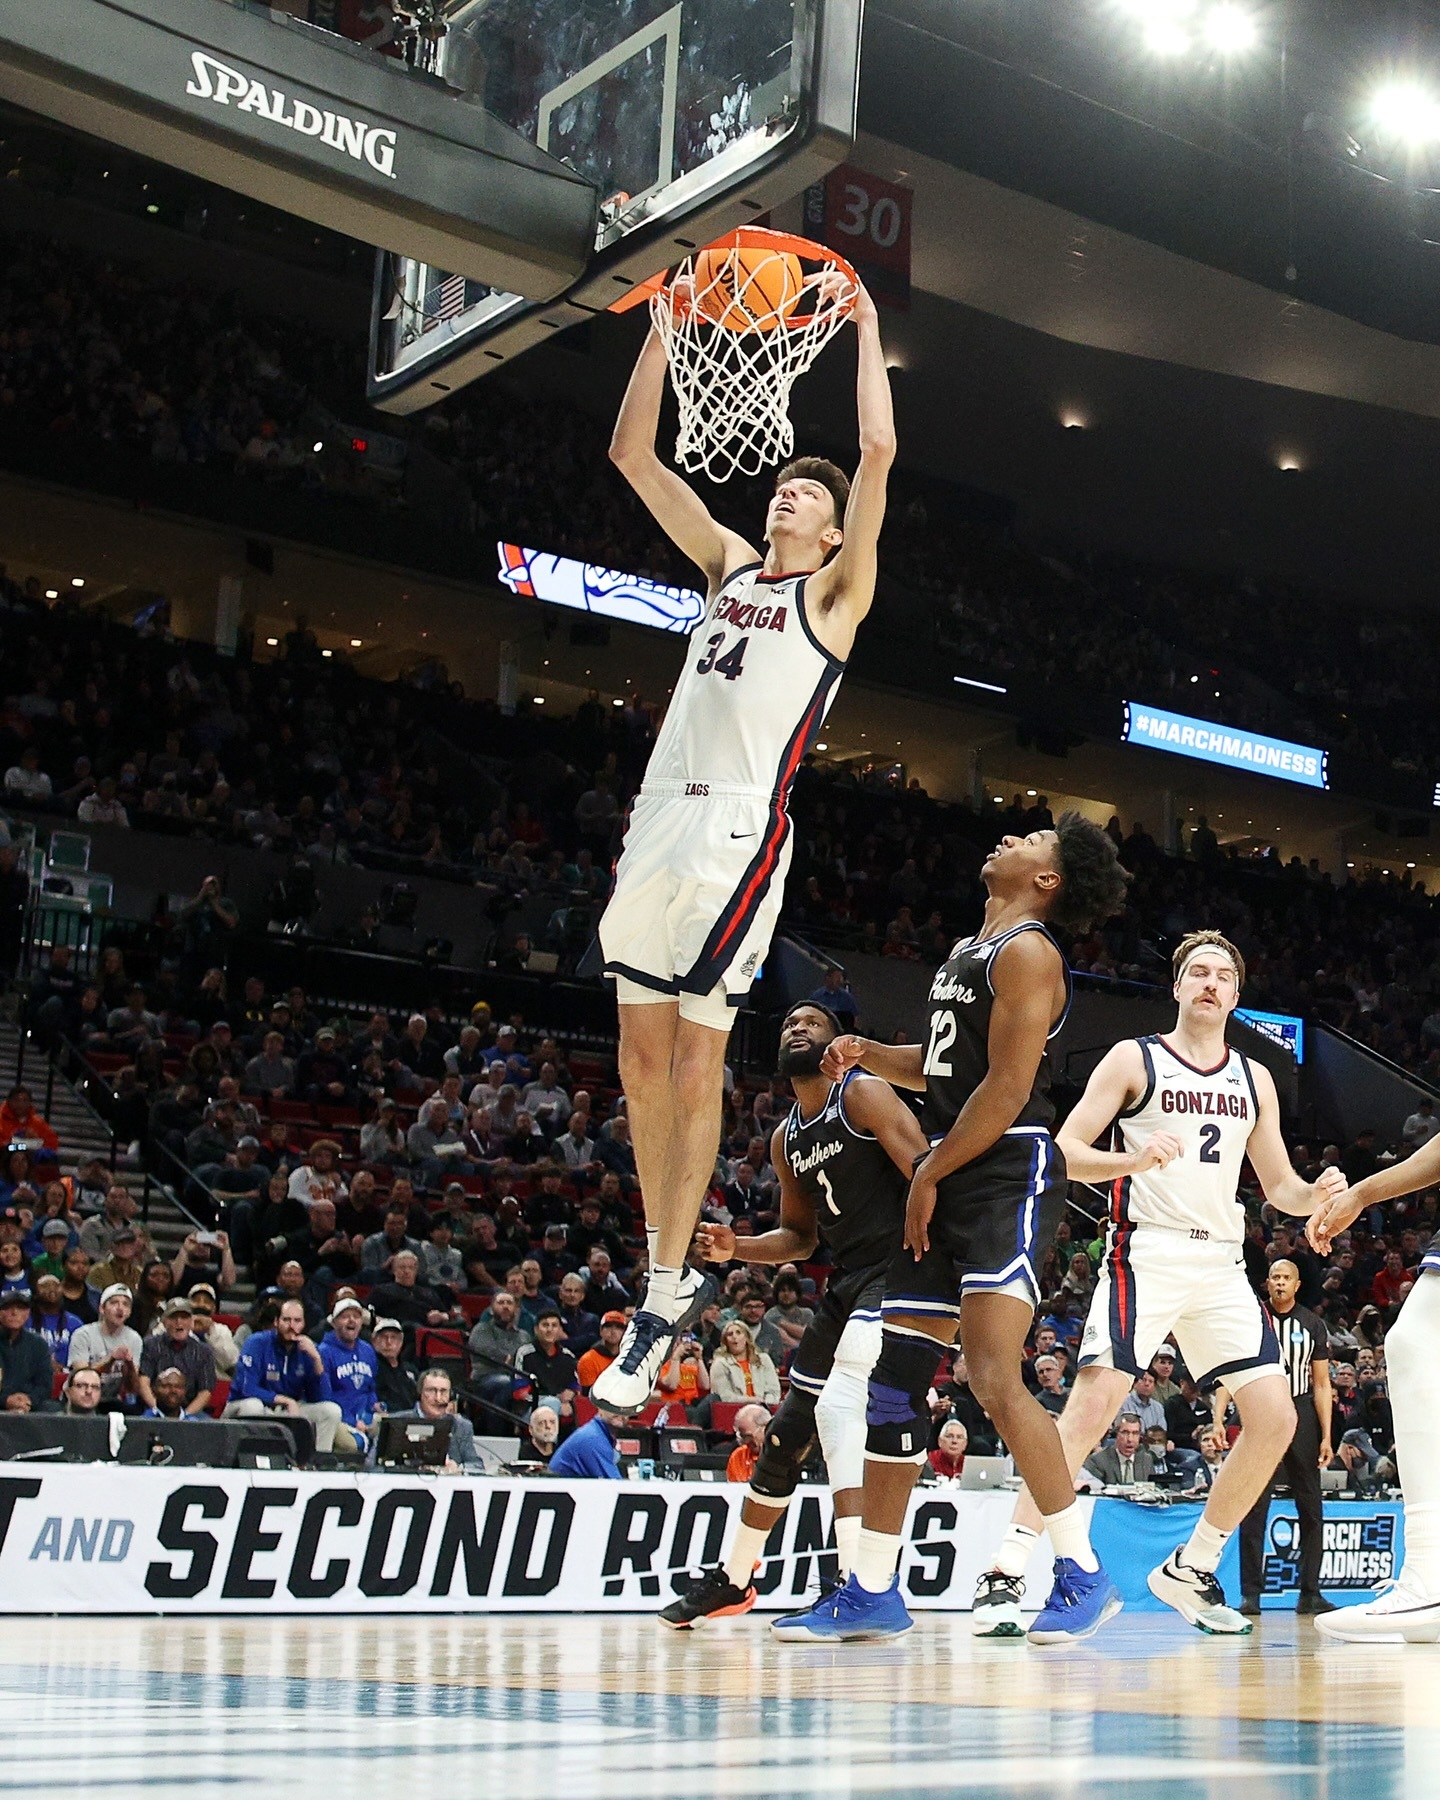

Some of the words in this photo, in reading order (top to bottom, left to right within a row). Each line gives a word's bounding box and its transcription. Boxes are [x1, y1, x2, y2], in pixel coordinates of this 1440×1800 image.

[186, 51, 398, 179] SPALDING
[835, 183, 901, 248] 30
[713, 595, 788, 633] GONZAGA
[696, 631, 750, 681] 34
[1136, 715, 1318, 776] #MARCHMADNESS
[685, 783, 710, 796] ZAGS
[923, 1010, 957, 1077] 12
[1161, 1089, 1248, 1120] GONZAGA
[790, 1140, 844, 1178] Panthers
[1199, 1123, 1221, 1164] 2
[816, 1169, 841, 1216] 1
[1190, 1228, 1210, 1241] ZAGS
[29, 1517, 135, 1562] AND
[144, 1485, 577, 1598] SECOND
[1319, 1551, 1392, 1579] ADNESS
